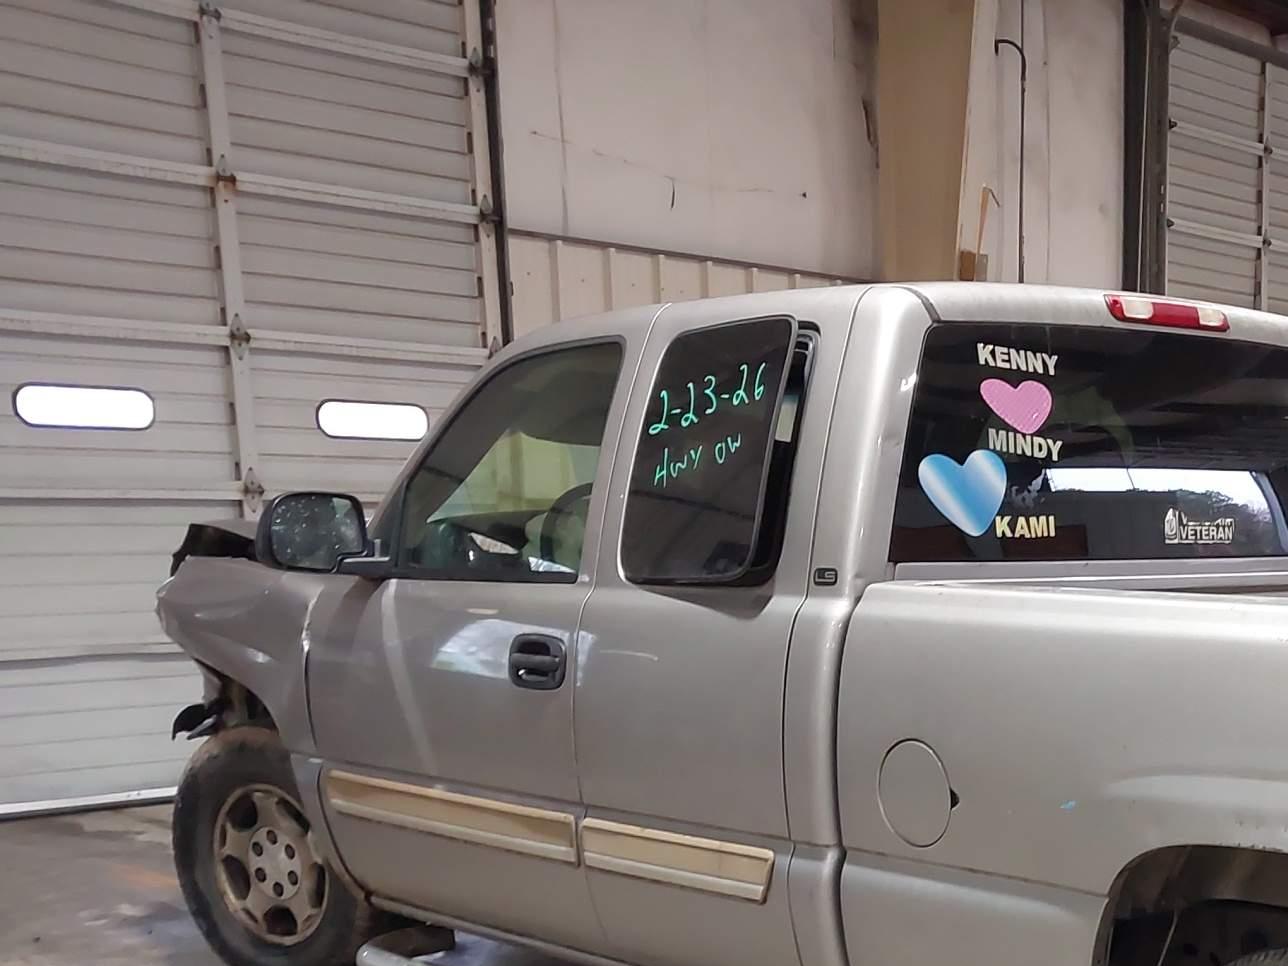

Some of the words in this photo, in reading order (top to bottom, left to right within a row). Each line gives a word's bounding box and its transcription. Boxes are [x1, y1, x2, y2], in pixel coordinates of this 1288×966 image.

[977, 342, 1059, 376] KENNY
[648, 361, 767, 435] 2-23-26
[988, 427, 1063, 462] MINDY
[995, 515, 1056, 538] KAMI
[1179, 525, 1233, 541] VETERAN
[815, 571, 836, 582] LS
